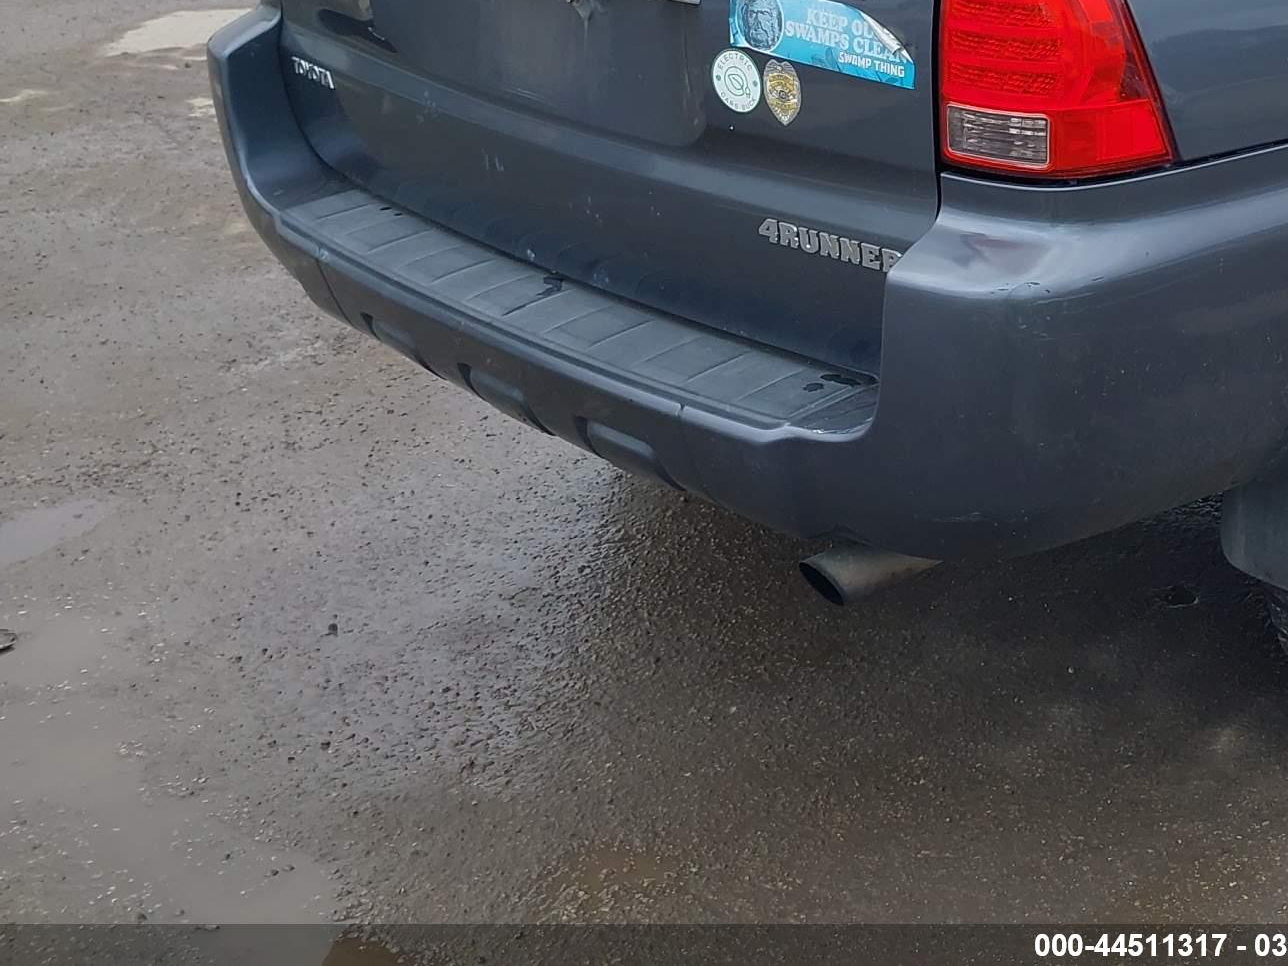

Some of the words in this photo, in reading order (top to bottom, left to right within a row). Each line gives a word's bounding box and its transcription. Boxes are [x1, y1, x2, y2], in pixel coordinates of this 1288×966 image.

[806, 8, 848, 32] KEEP
[785, 20, 850, 51] SWAMPS
[717, 53, 752, 71] ELECTRIC
[838, 52, 871, 68] SWAMP
[874, 61, 905, 78] THING
[758, 218, 902, 272] 4RUNNER
